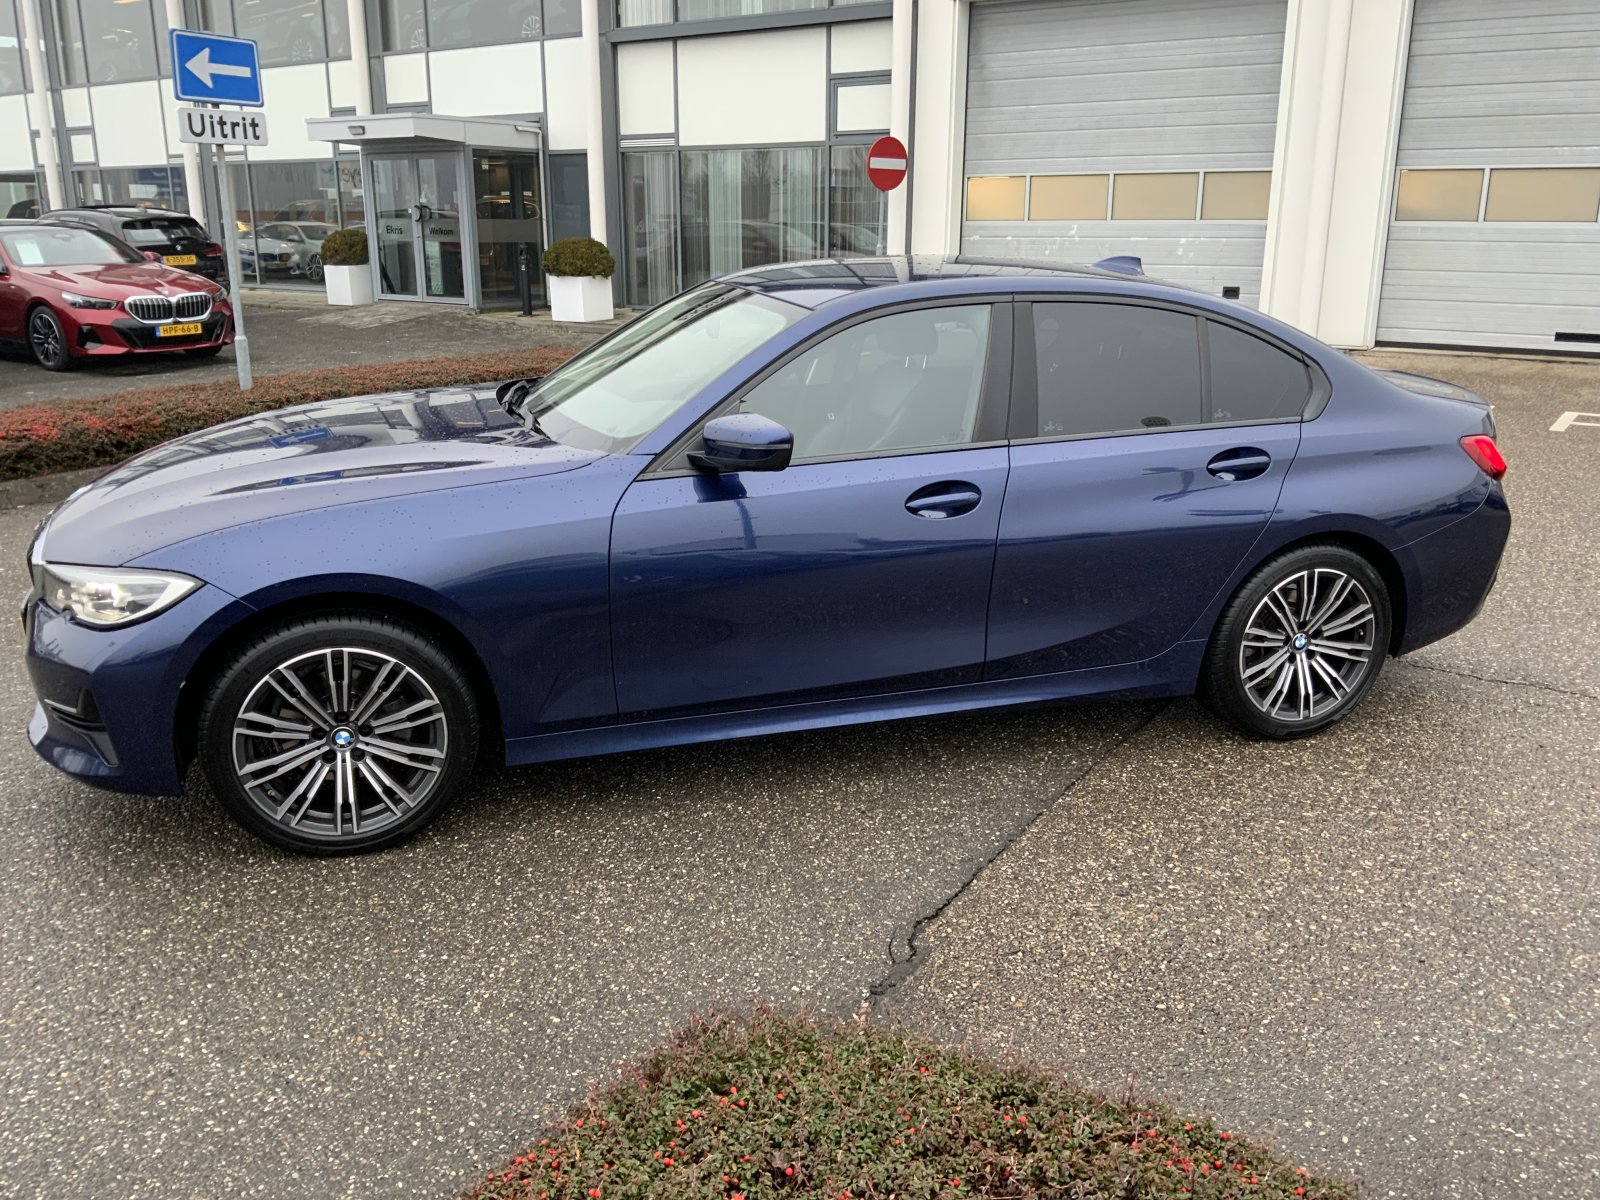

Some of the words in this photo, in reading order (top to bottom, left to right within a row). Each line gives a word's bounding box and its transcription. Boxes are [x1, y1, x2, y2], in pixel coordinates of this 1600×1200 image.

[187, 112, 260, 140] Uitrit
[386, 225, 403, 235] Ekris
[429, 227, 454, 236] Welkom
[162, 324, 199, 335] HPF-66-B
